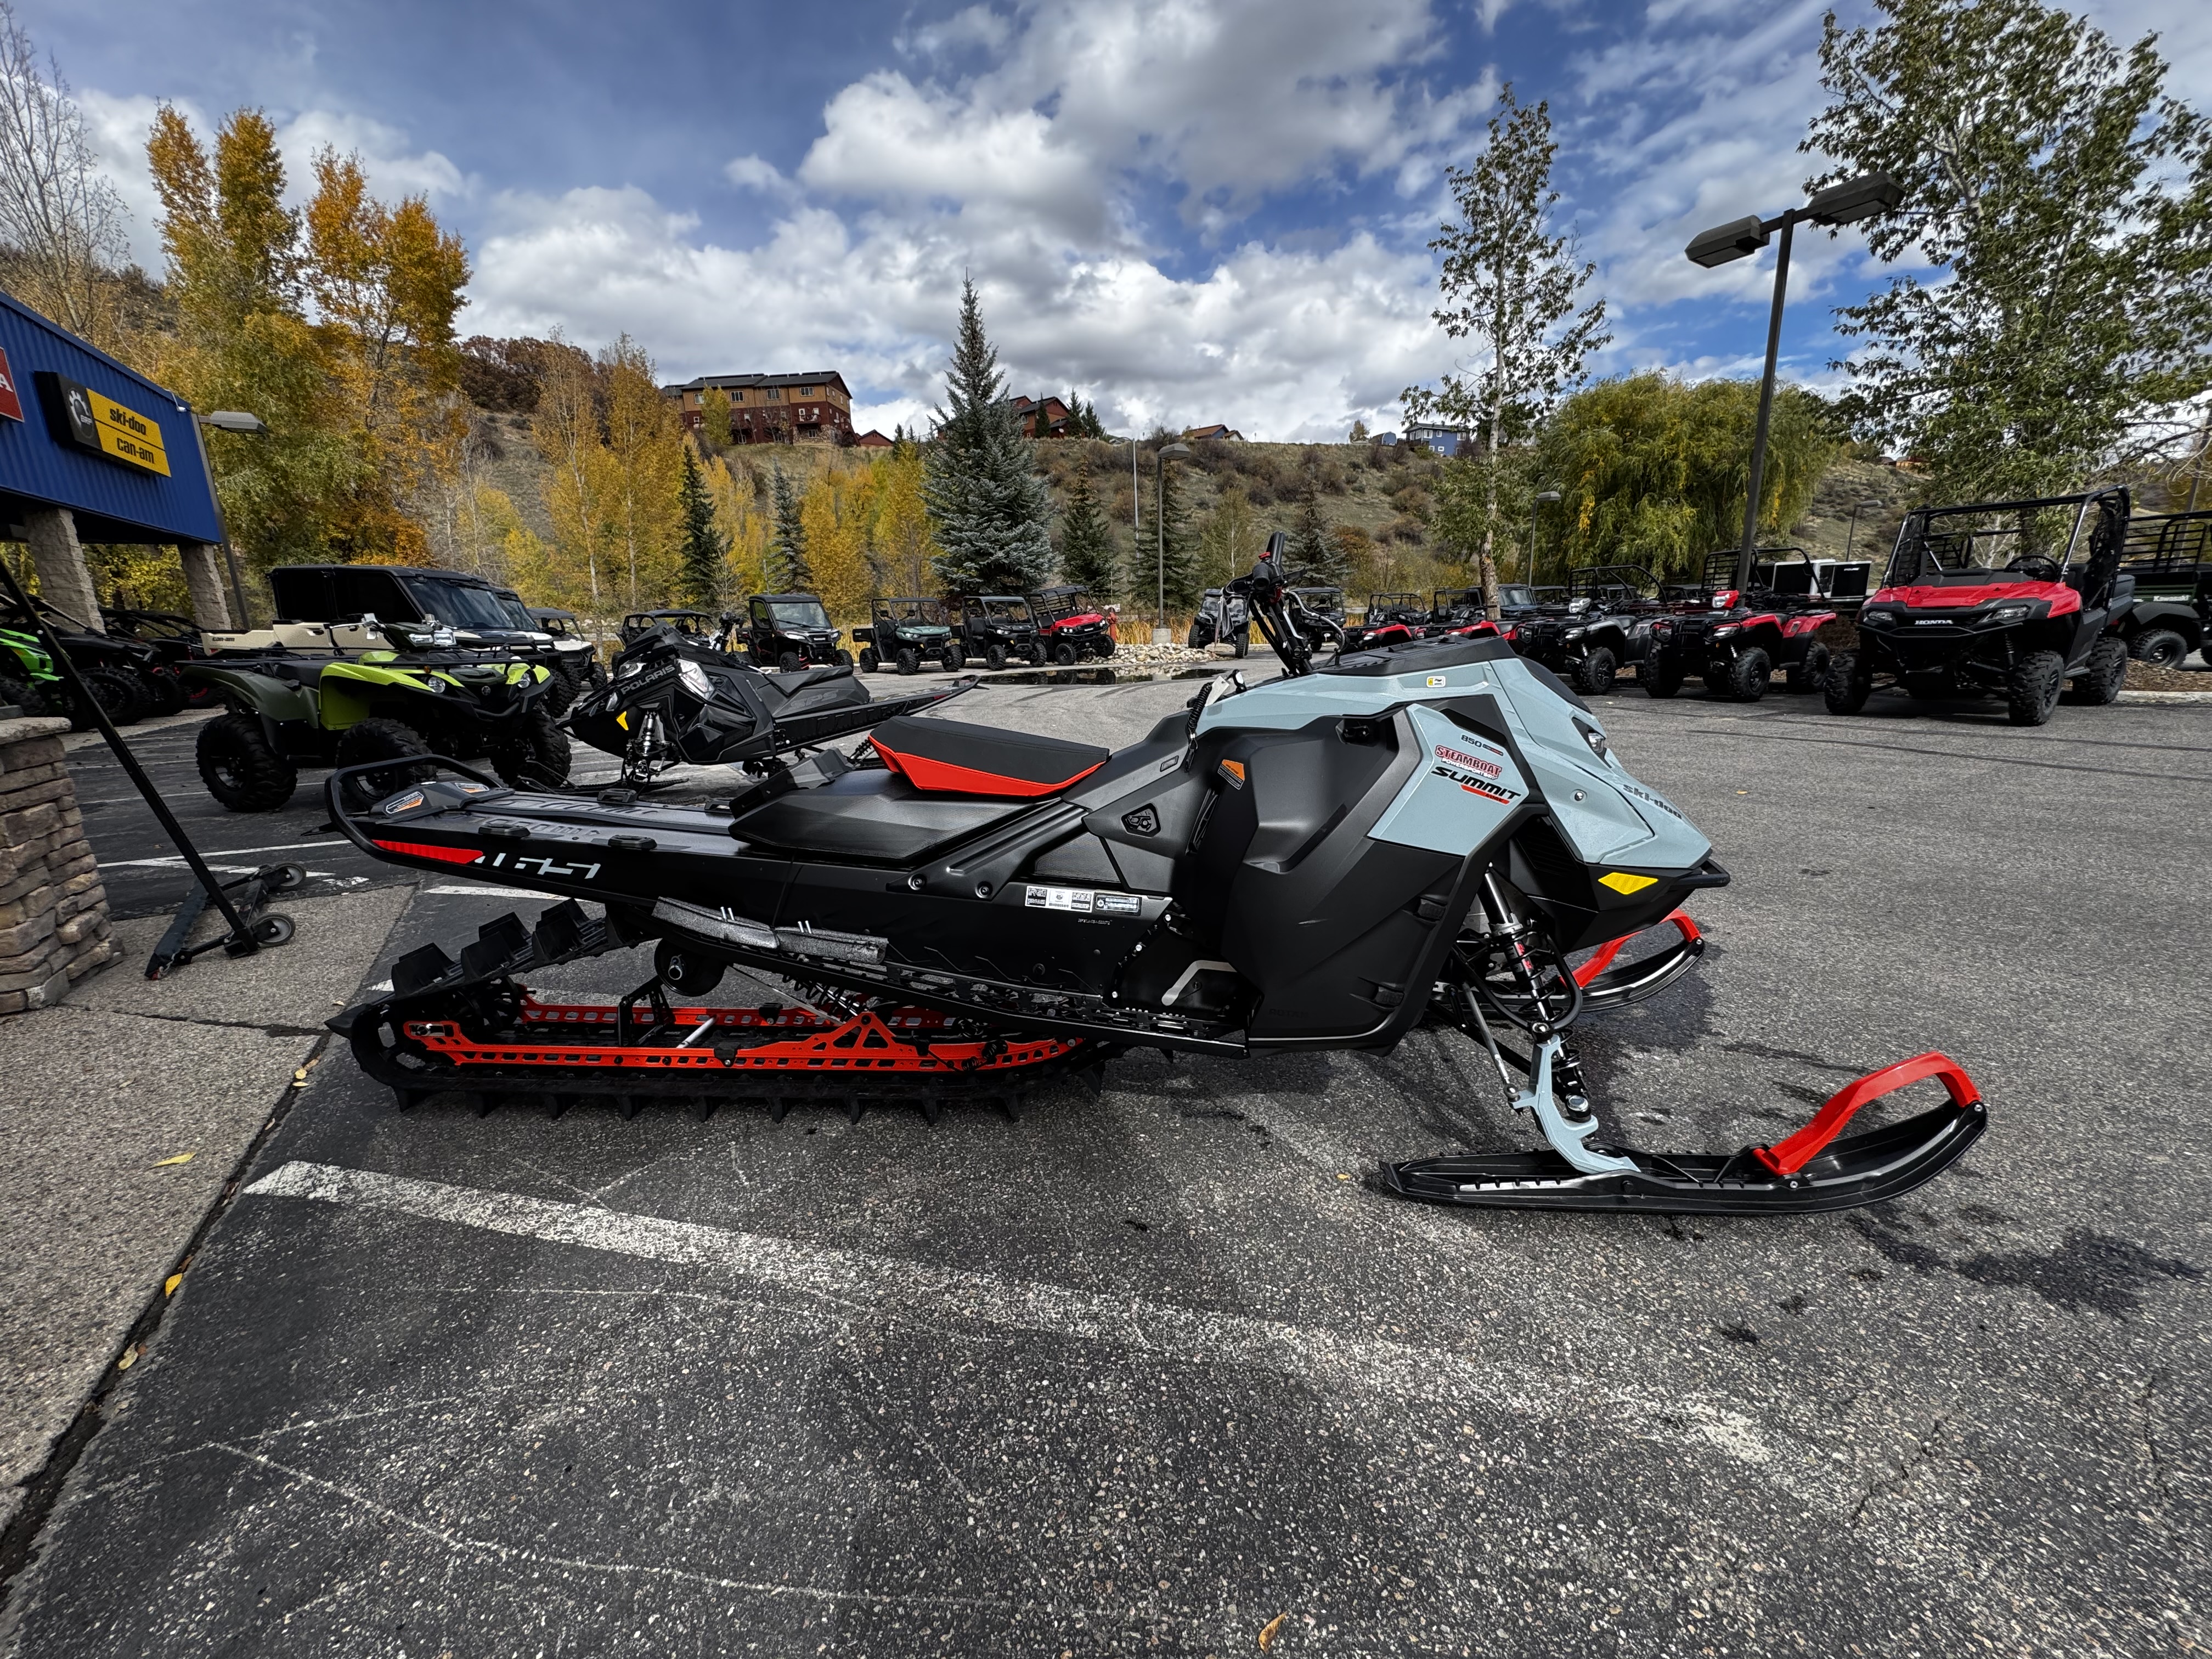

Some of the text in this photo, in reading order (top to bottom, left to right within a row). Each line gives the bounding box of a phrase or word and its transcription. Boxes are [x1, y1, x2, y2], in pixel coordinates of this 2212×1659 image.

[110, 408, 146, 436] ski-doo
[116, 437, 155, 464] can-am
[620, 664, 675, 695] POLARIS
[1461, 735, 1482, 748] 850
[1435, 746, 1502, 776] STEAMBOAT
[1441, 758, 1490, 778] POWERSPORTS
[1431, 766, 1521, 800] SUMMIT
[1623, 784, 1682, 820] ski-doo
